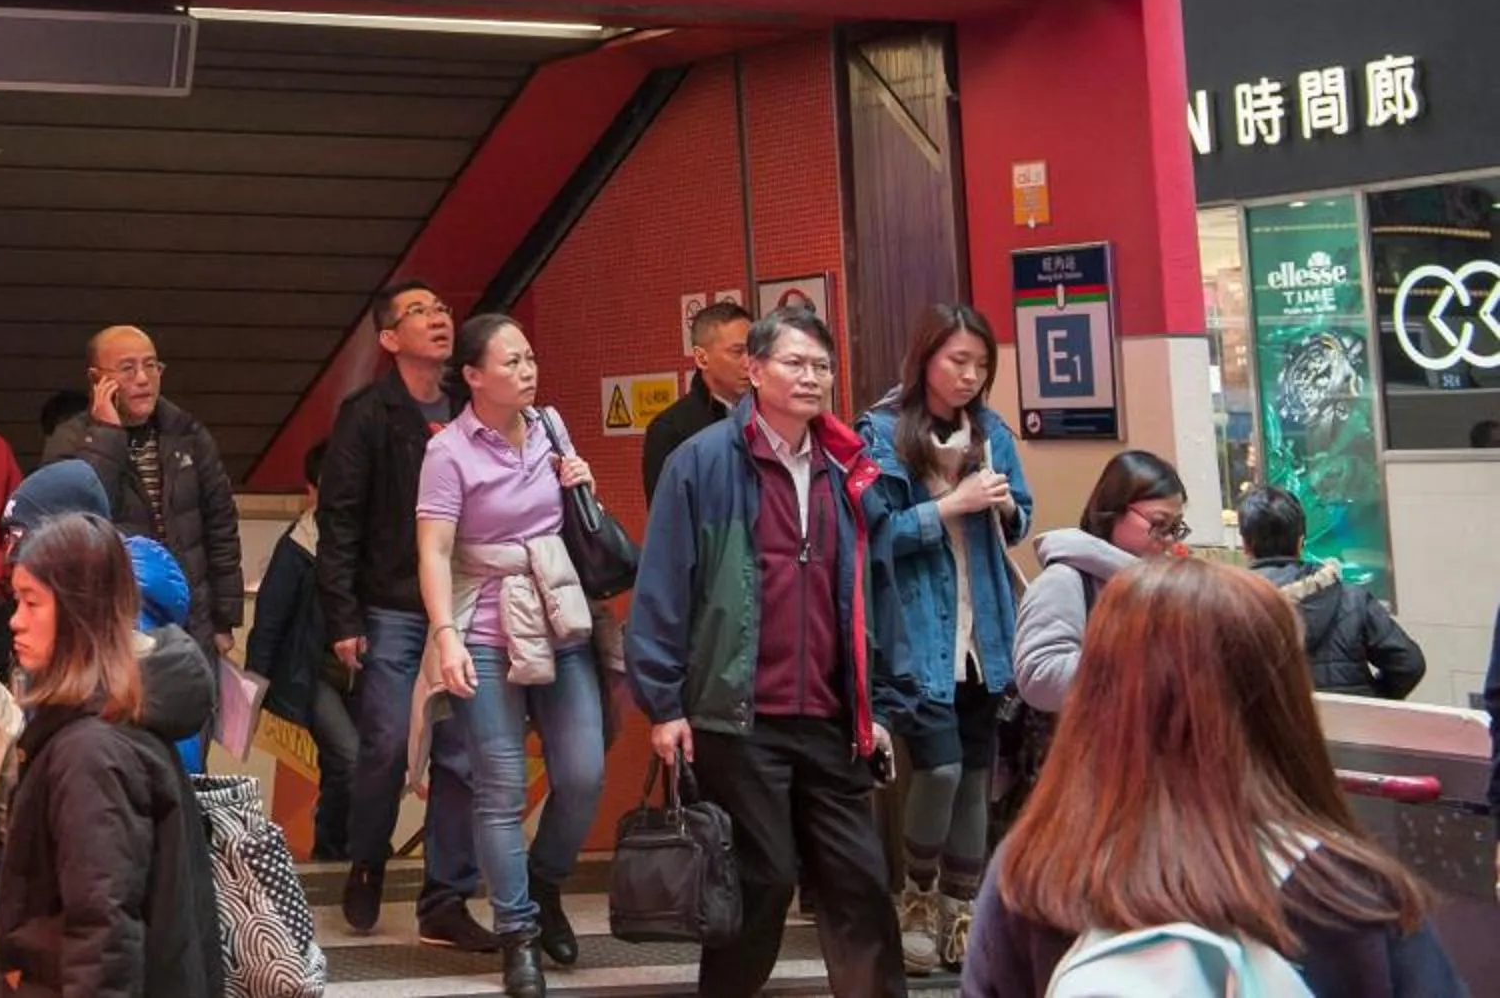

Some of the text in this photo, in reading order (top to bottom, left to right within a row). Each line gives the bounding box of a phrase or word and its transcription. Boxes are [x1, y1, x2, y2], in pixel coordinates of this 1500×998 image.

[1234, 53, 1419, 146] 時間廊
[1267, 261, 1347, 290] ellesse
[1283, 288, 1335, 305] TIME
[1047, 329, 1082, 382] E1
